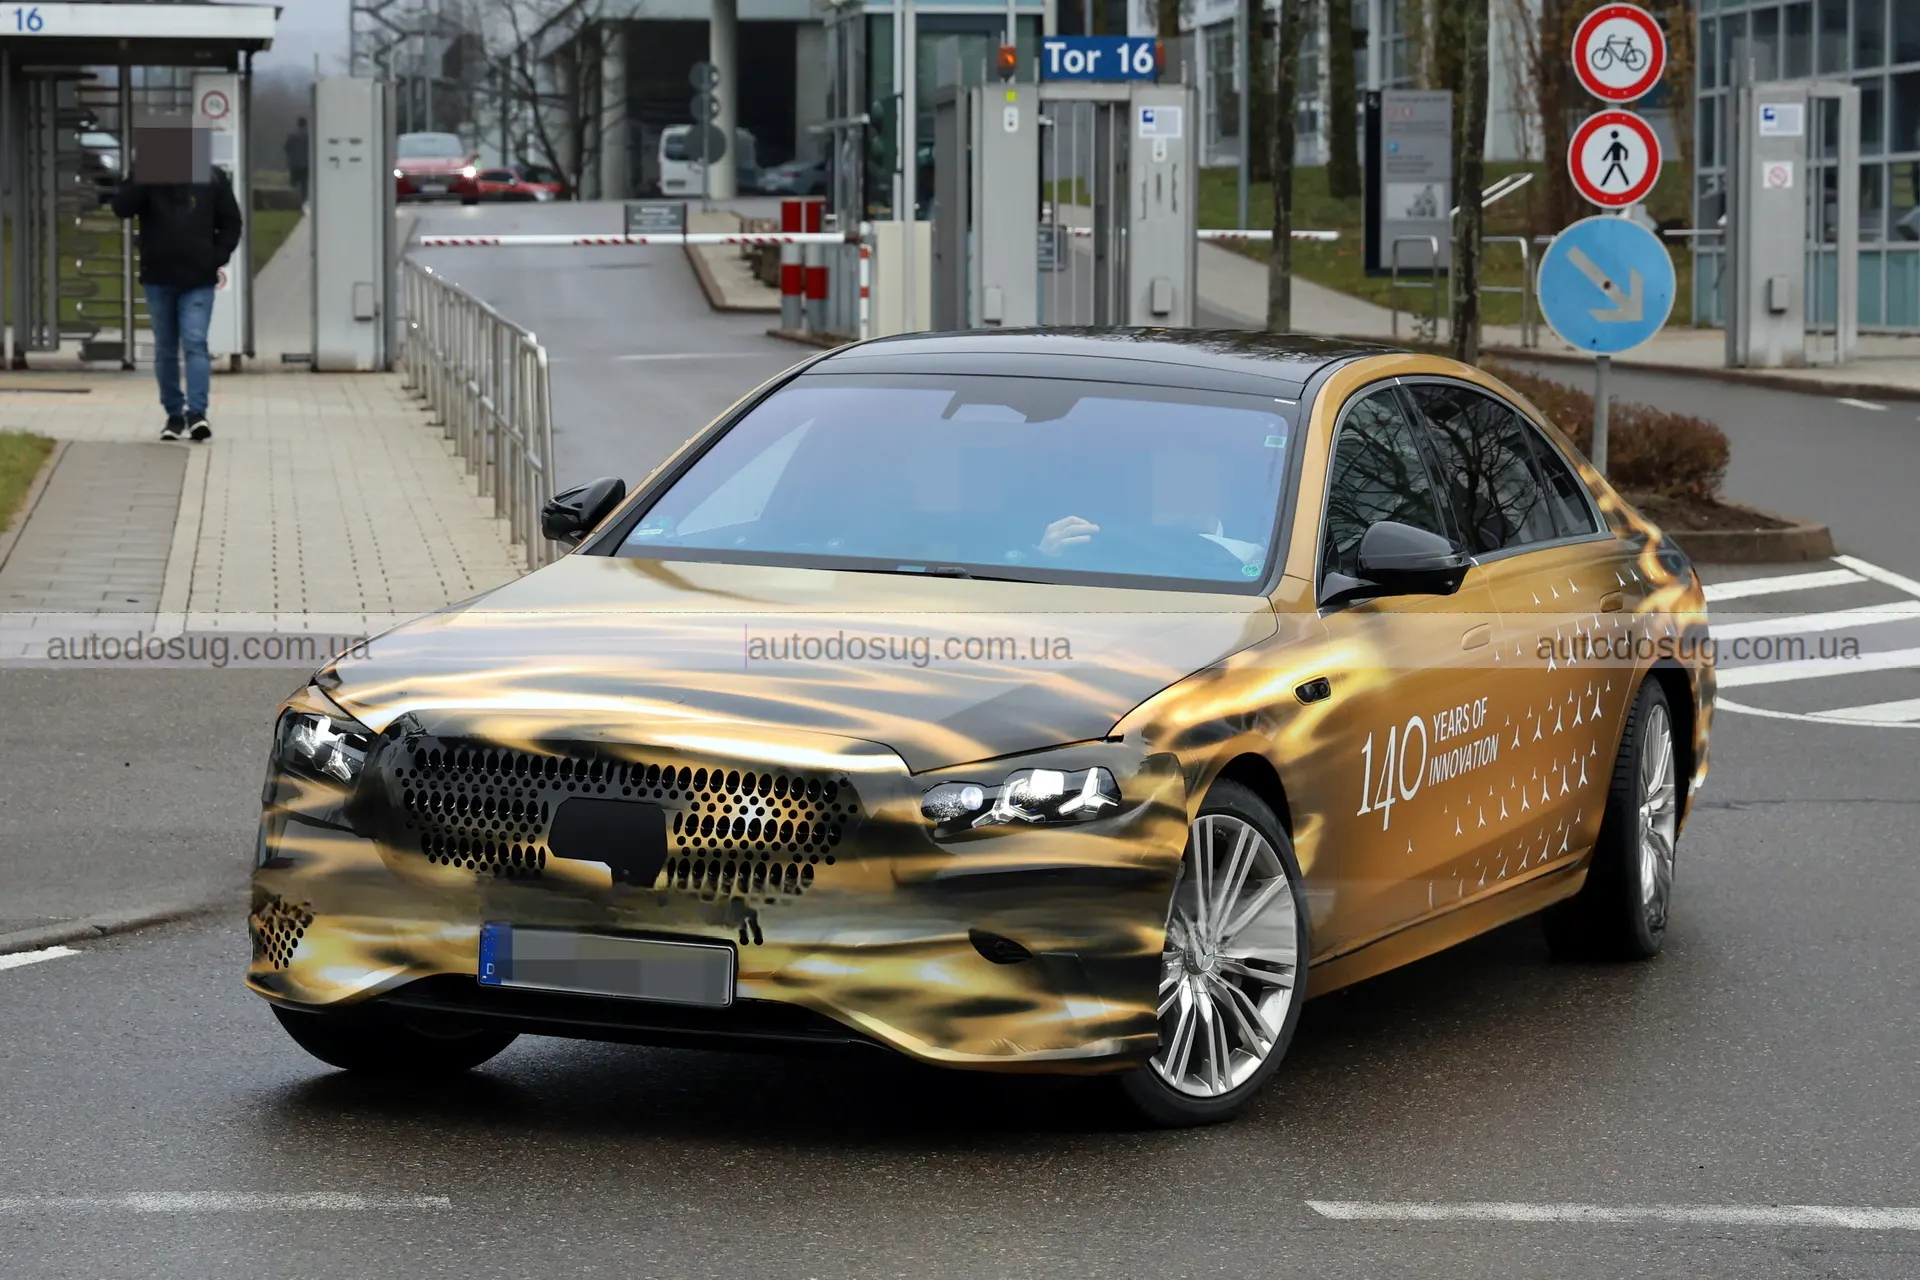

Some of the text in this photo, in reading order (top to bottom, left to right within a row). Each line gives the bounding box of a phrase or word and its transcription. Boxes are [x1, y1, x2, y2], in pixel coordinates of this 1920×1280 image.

[12, 7, 44, 32] 16
[1044, 41, 1154, 74] Tor 16
[1433, 697, 1488, 743] YEARS OF
[1357, 715, 1427, 831] 140
[1428, 733, 1500, 787] INNOVATION
[486, 963, 495, 975] D
